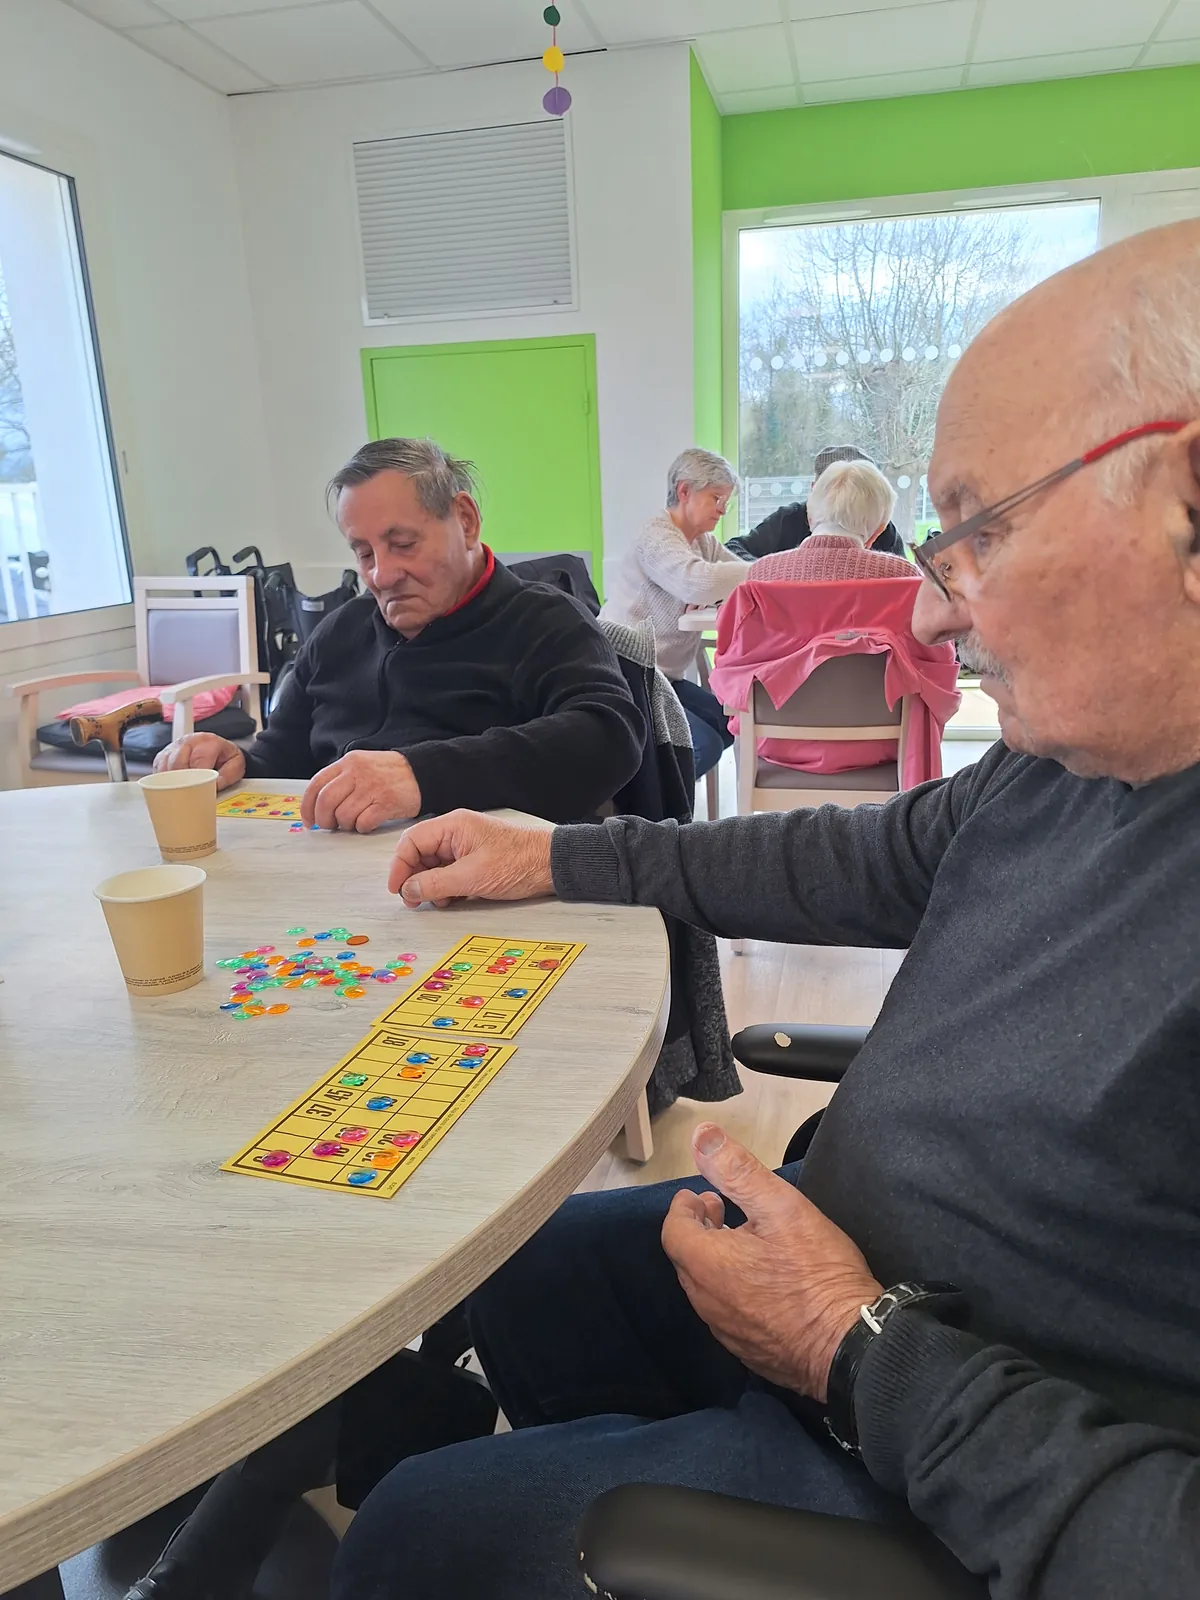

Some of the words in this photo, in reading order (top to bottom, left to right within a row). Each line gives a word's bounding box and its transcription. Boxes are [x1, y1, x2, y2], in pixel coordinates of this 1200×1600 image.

[417, 993, 442, 1003] 20
[482, 1011, 507, 1019] 17
[382, 1035, 411, 1047] 81
[323, 1088, 354, 1102] 45
[305, 1103, 337, 1118] 37
